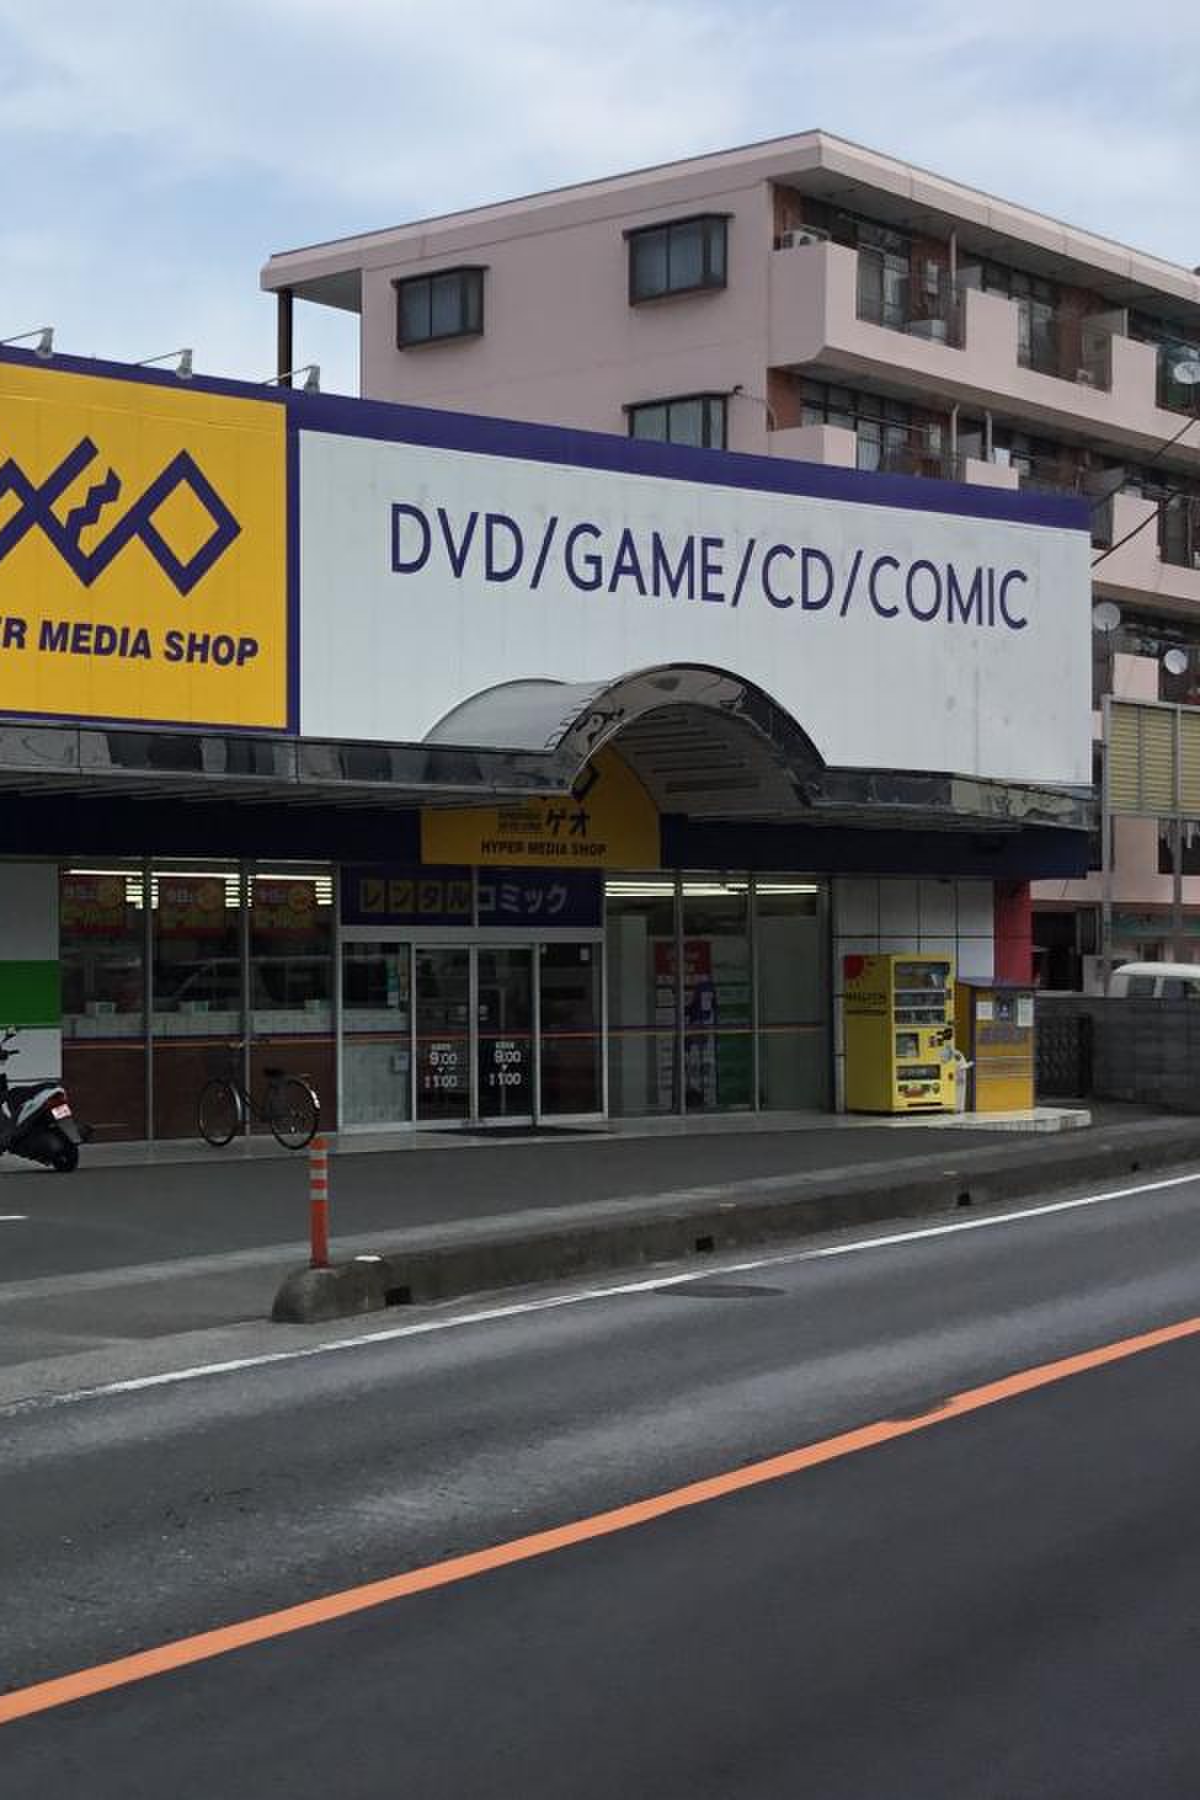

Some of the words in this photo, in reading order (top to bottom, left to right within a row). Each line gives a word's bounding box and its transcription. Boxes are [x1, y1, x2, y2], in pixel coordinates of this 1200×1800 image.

[390, 503, 1029, 629] DVD/GAME/CD/COMIC
[38, 620, 152, 660] MEDIA
[164, 630, 259, 667] SHOP
[481, 840, 525, 855] HYPER
[527, 841, 568, 856] MEDIA
[571, 842, 607, 857] SHOP
